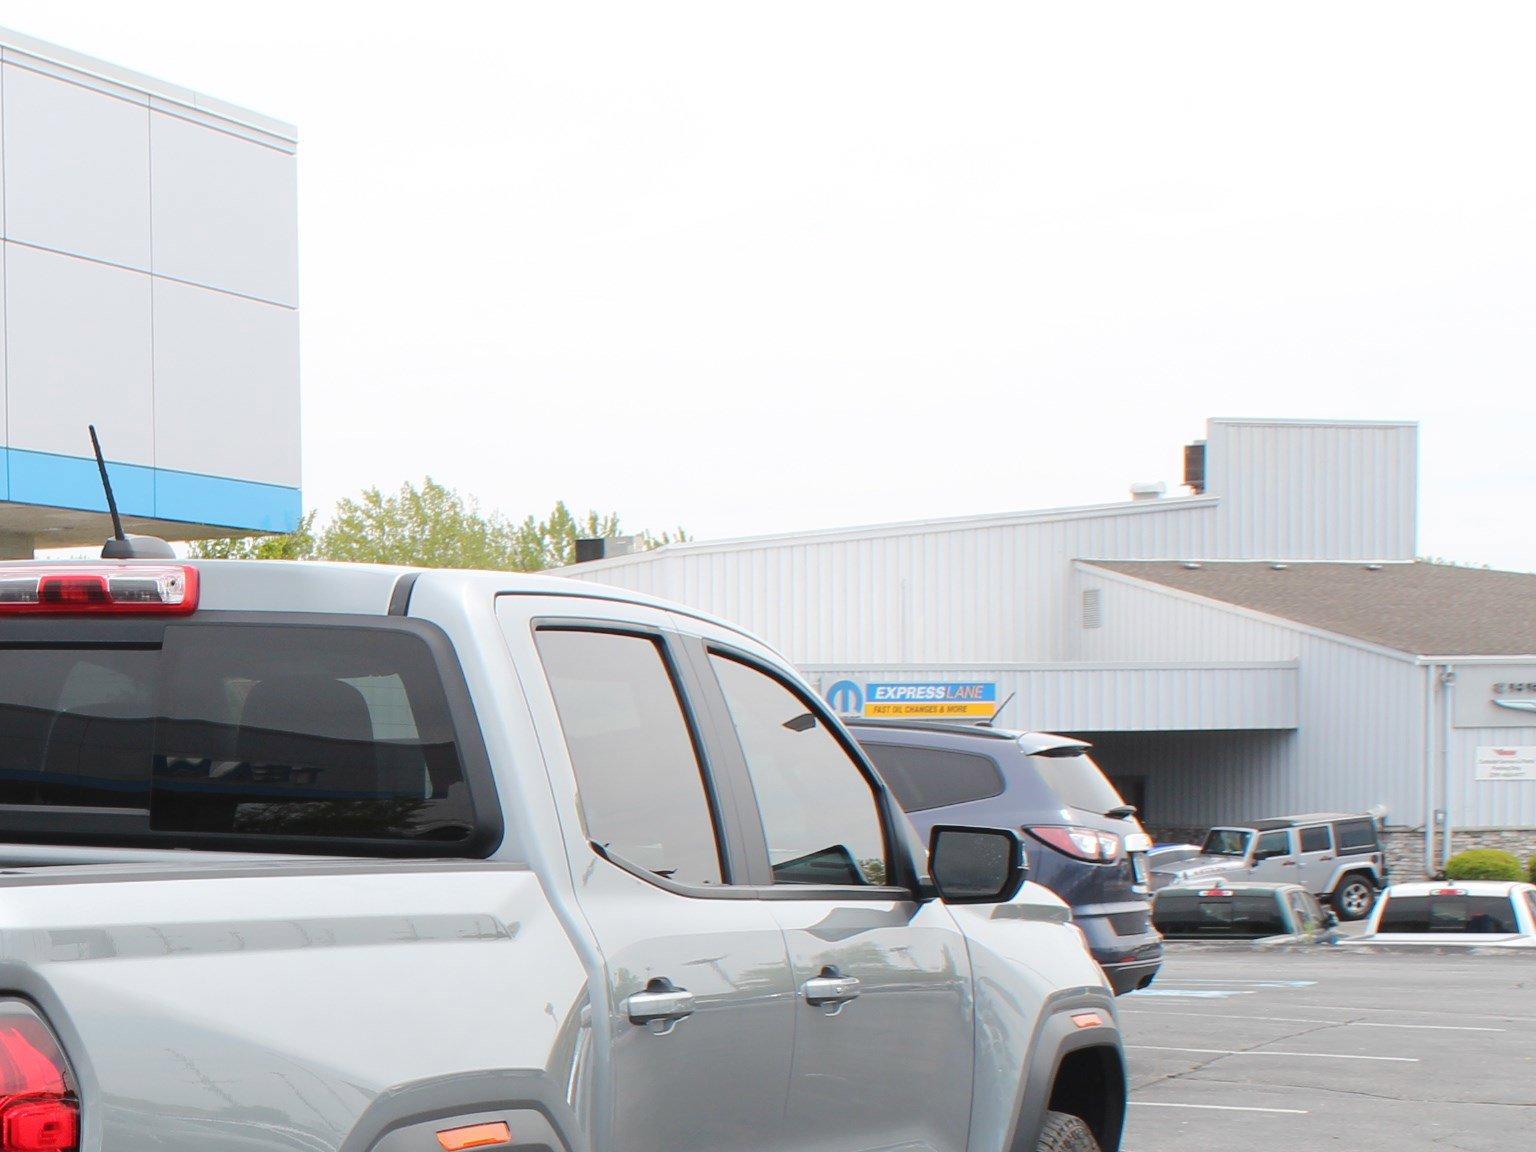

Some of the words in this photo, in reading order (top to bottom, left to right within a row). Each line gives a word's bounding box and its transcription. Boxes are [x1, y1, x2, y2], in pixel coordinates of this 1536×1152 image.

[873, 705, 891, 714] FAST
[905, 705, 938, 714] CHANGES
[946, 705, 968, 714] MORE
